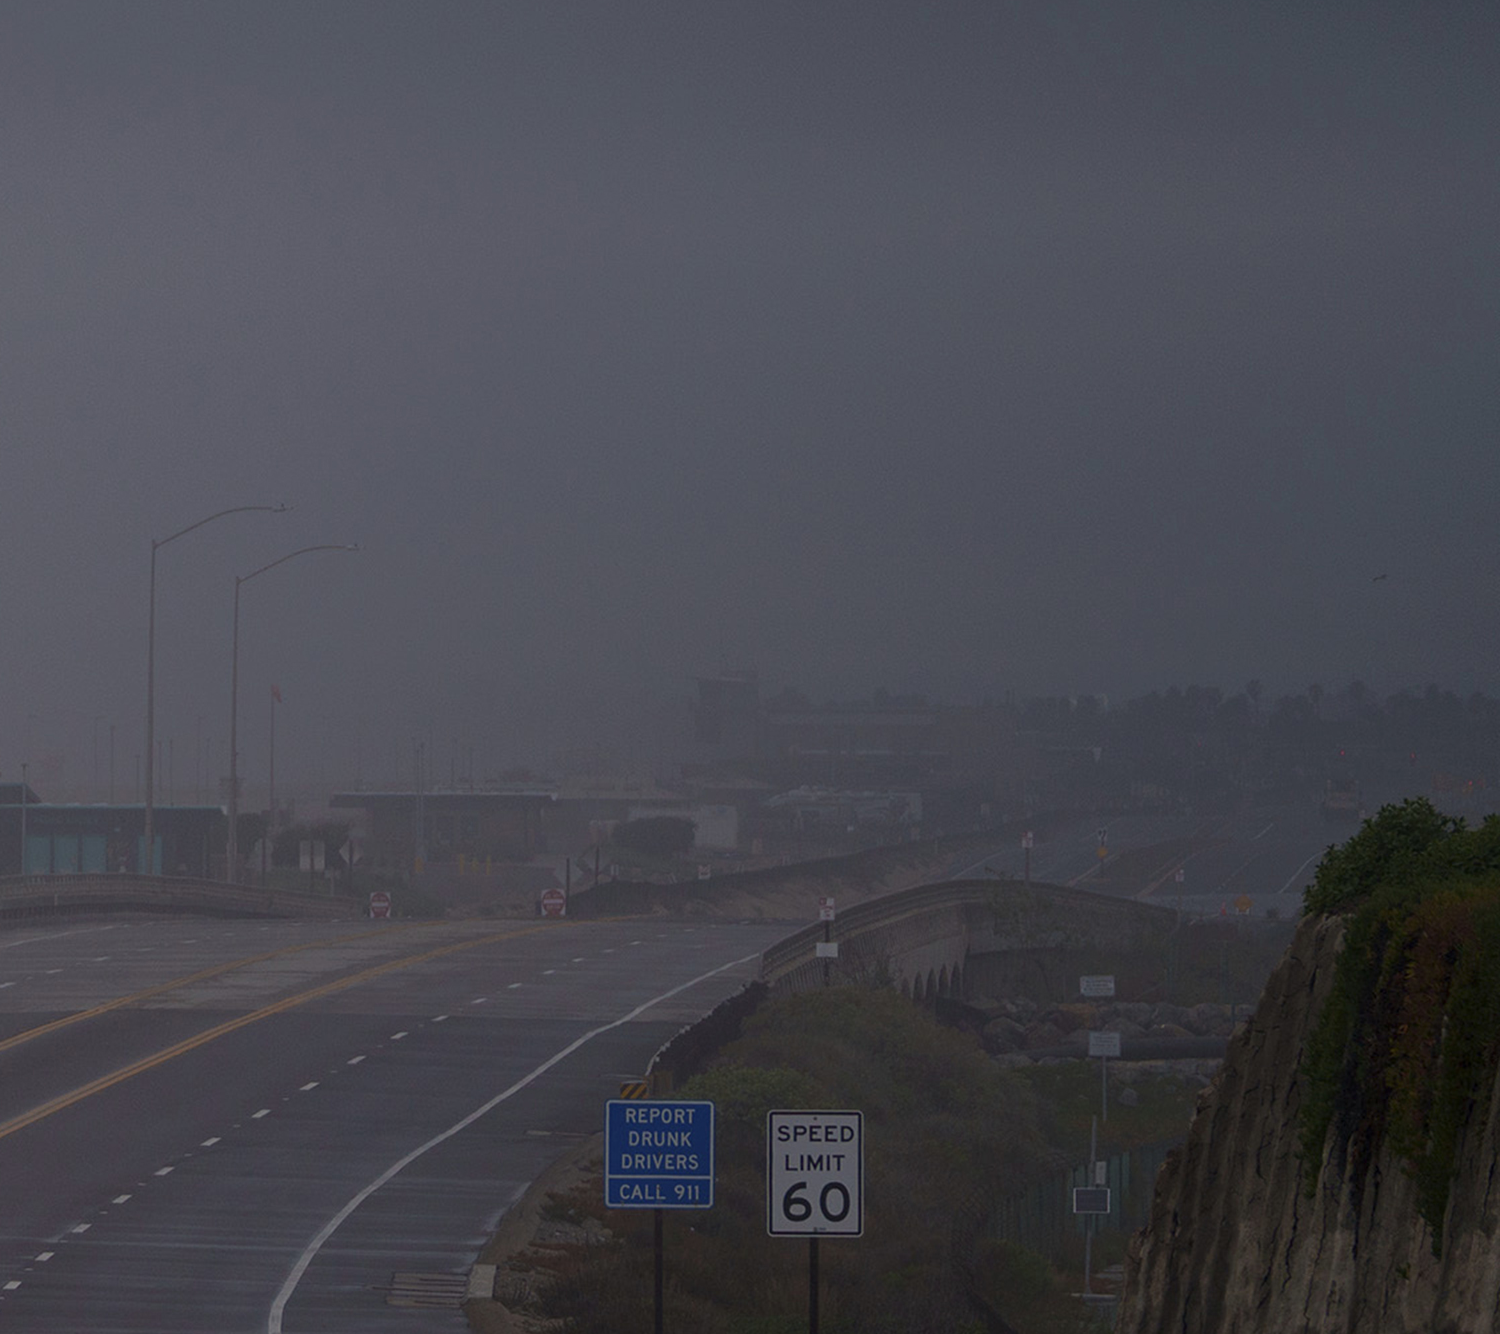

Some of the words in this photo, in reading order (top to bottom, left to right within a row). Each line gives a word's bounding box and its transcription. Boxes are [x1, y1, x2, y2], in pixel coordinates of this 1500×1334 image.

[625, 1107, 696, 1124] REPORT
[628, 1130, 692, 1147] DRUNK
[777, 1125, 855, 1143] SPEED
[621, 1153, 699, 1170] DRIVERS
[785, 1154, 845, 1172] LIMIT
[619, 1184, 666, 1200] CALL
[674, 1184, 700, 1200] 911
[782, 1181, 851, 1223] 60
